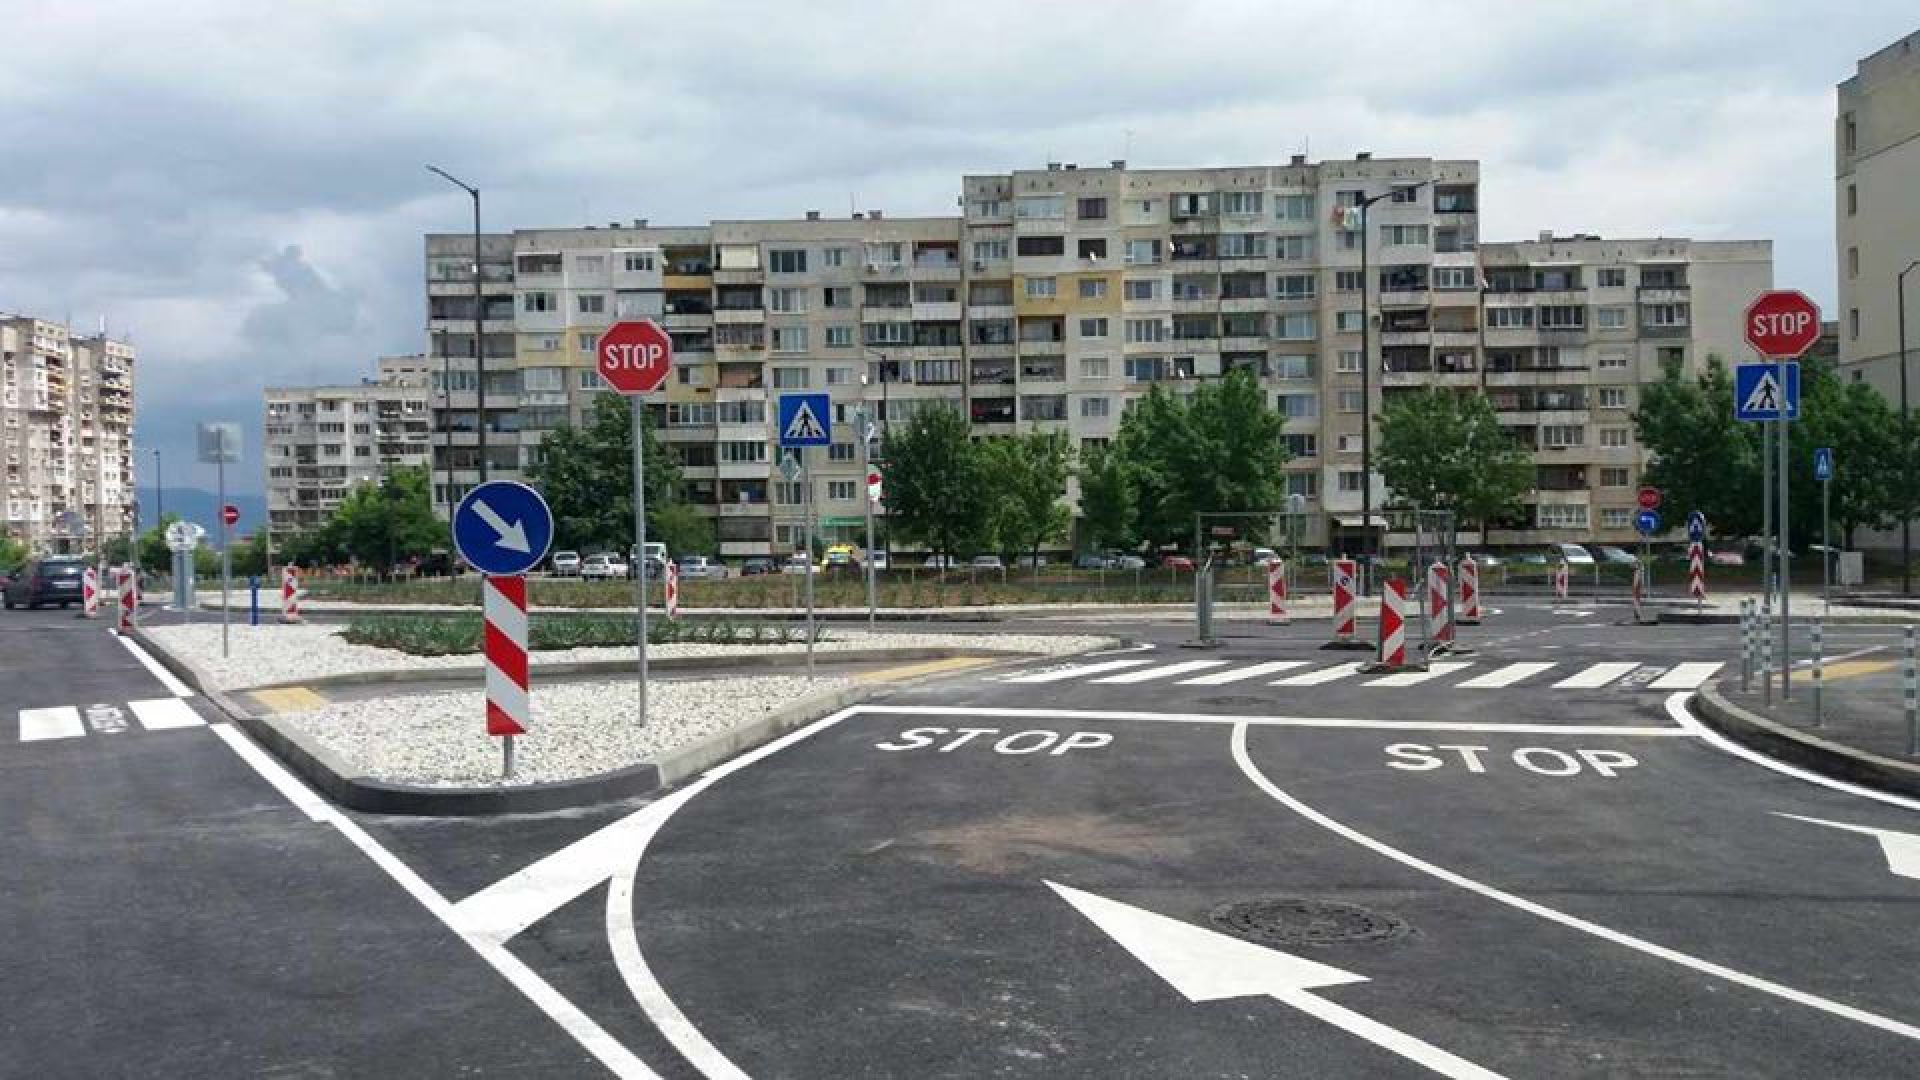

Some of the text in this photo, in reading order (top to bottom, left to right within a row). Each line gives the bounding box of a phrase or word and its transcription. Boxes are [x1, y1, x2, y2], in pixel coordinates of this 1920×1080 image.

[1753, 311, 1811, 337] STOP
[605, 343, 663, 370] STOP
[874, 727, 1115, 756] STOP
[1383, 743, 1640, 777] STOP
